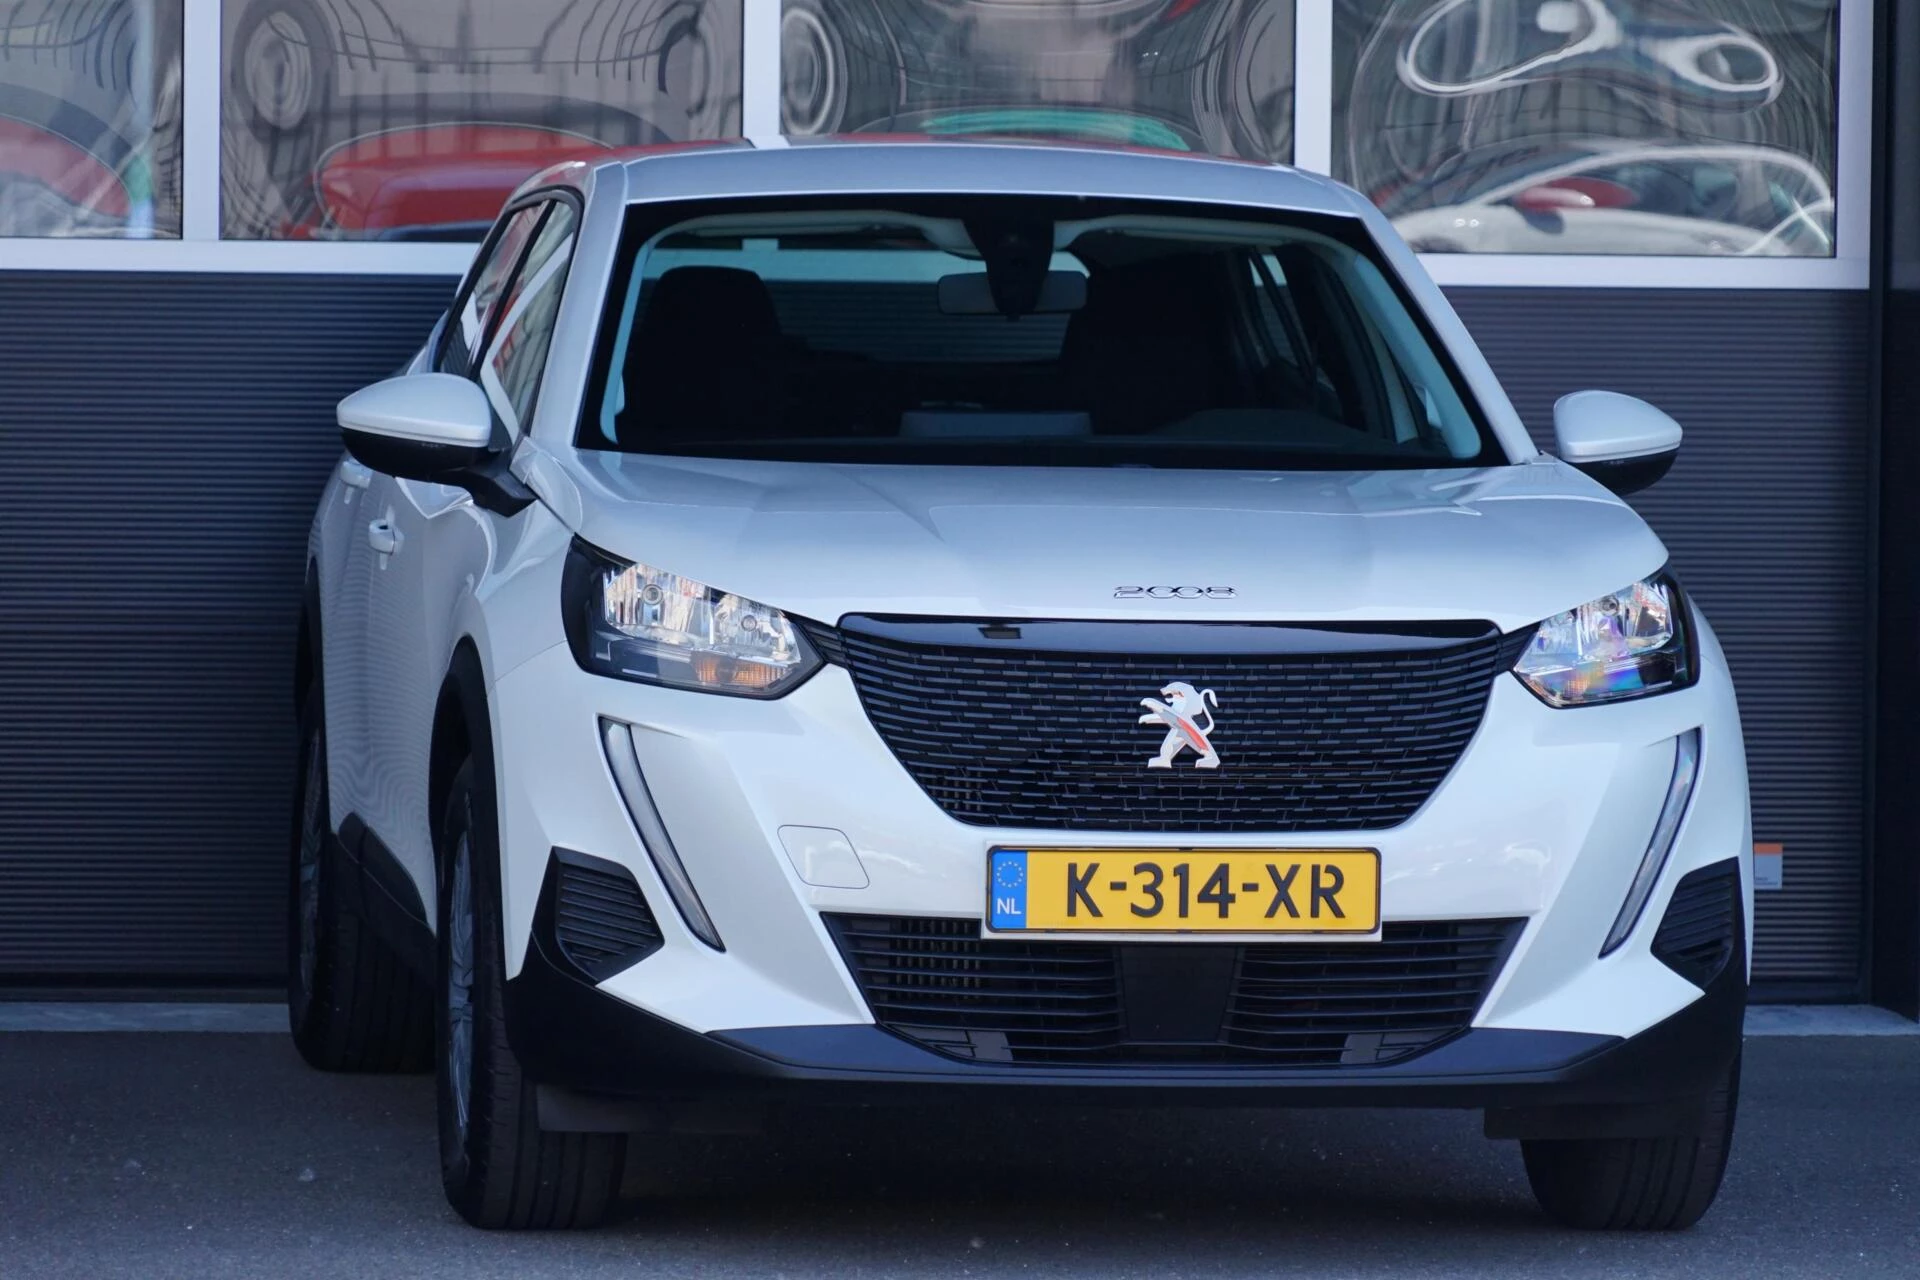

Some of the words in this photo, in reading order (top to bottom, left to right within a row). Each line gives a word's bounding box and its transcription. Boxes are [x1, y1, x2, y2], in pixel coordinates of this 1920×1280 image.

[1113, 585, 1238, 600] 2008
[1066, 861, 1347, 919] K-314-XR
[996, 897, 1022, 915] NL
